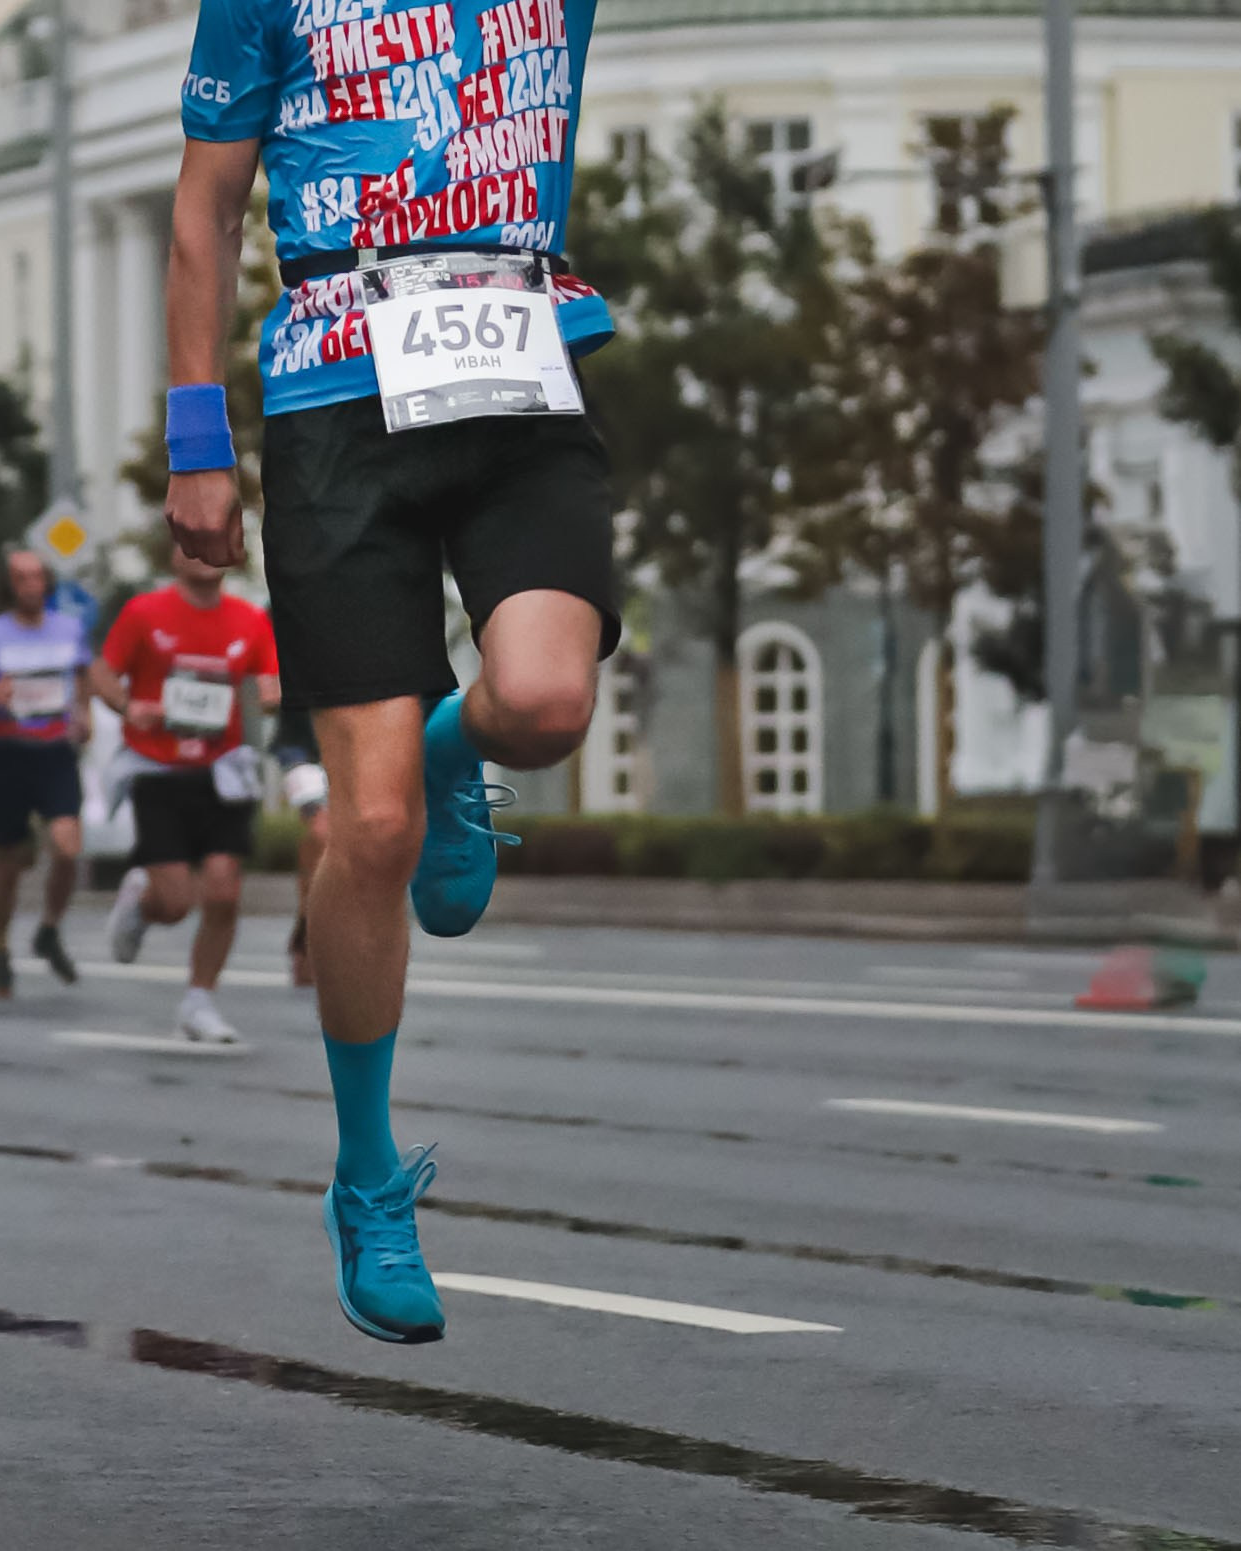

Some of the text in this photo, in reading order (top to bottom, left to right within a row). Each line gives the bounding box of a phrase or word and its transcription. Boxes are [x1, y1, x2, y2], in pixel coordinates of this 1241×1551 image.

[308, 2, 456, 82] #МЕЧТА
[184, 72, 231, 104] ПСБ
[413, 48, 572, 151] ЗАБЕГ2024
[402, 303, 531, 357] 4567
[454, 355, 502, 370] ИВАН
